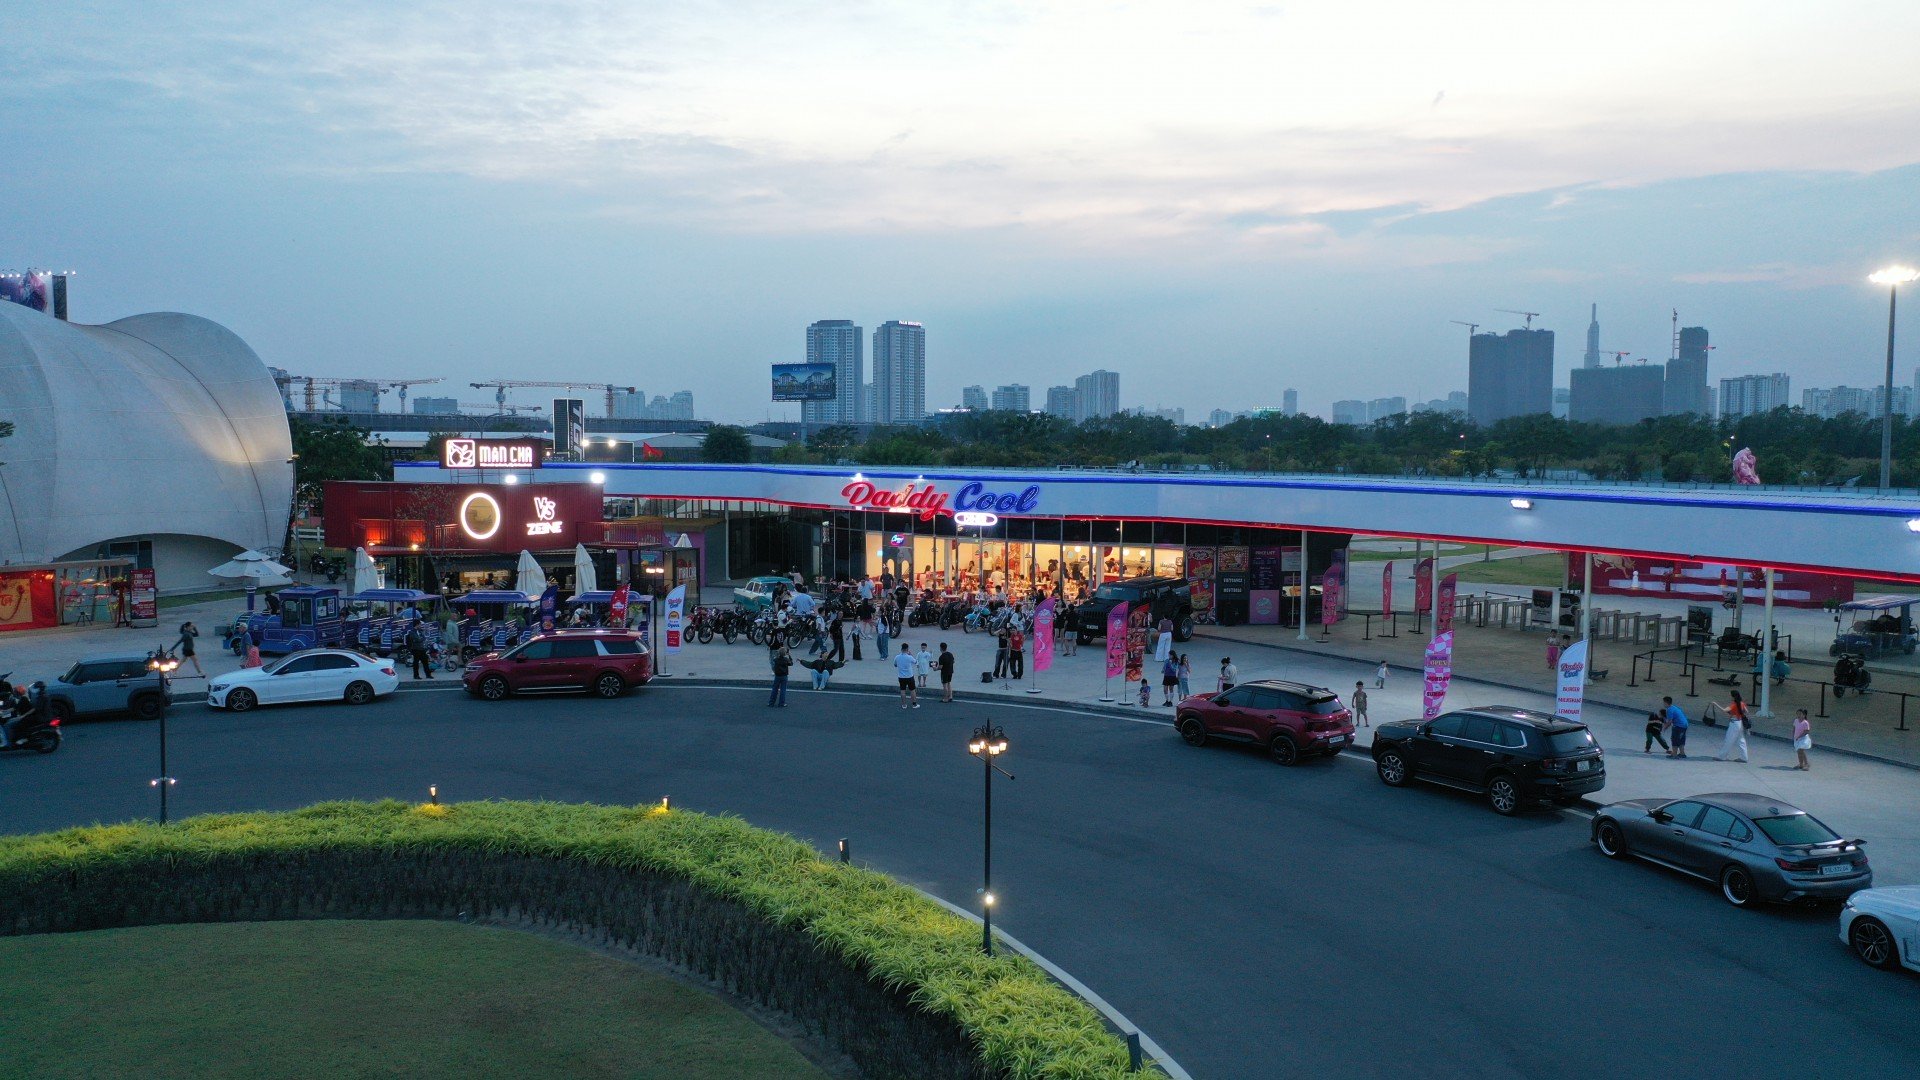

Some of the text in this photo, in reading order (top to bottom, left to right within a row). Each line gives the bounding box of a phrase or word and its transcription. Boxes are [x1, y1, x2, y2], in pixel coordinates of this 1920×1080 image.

[479, 446, 533, 462] MAN CHA
[533, 497, 556, 521] VS
[841, 482, 1040, 522] Daddy Cool
[1560, 662, 1584, 672] Daddy
[1563, 670, 1579, 678] Cool
